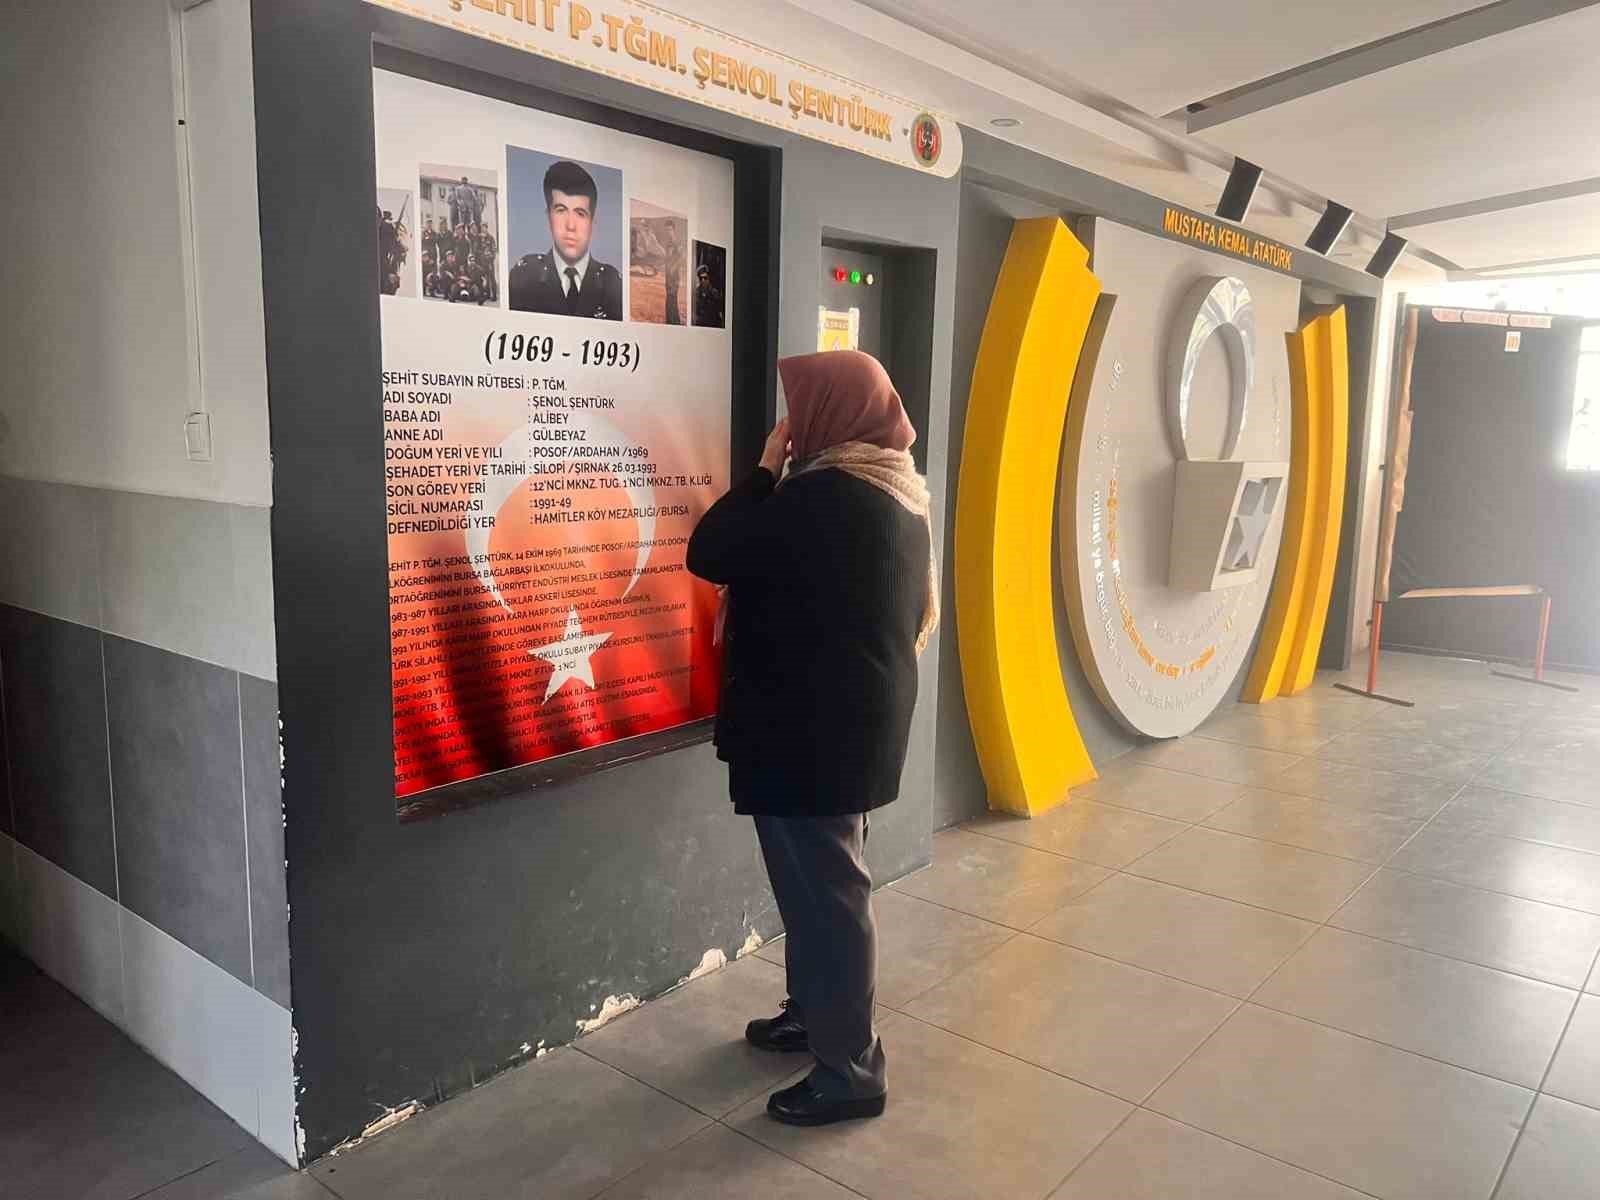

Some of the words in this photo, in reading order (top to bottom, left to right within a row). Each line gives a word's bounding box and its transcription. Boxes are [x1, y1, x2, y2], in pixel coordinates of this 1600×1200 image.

[692, 47, 783, 106] ŞENOL
[788, 79, 894, 142] ŞENTÜRK
[1164, 207, 1216, 247] MUSTAFA
[1217, 226, 1251, 257] KEMAL
[1252, 239, 1292, 270] ATATÜRK
[484, 330, 554, 368] (1969
[581, 338, 640, 373] 1993)
[382, 368, 419, 389] ŞEHİT
[421, 373, 473, 387] SUBAYIN
[477, 373, 524, 389] RÜTBESİ
[544, 376, 567, 390] TĞM.
[383, 390, 404, 403] ADI
[407, 391, 451, 404] SOYADI
[532, 396, 567, 411] ŞENOL
[569, 394, 615, 411] ŞENTÜRK
[384, 409, 418, 422] BABA
[419, 410, 440, 422] ADI
[532, 410, 568, 424] ALİBEY
[384, 428, 420, 440] ANNE
[422, 429, 443, 440] ADI
[532, 427, 586, 440] GÜLBEYAZ
[385, 444, 432, 459] DOĞUM
[435, 444, 462, 459] YERİ
[464, 447, 479, 458] VE
[482, 447, 502, 458] YILI
[533, 446, 619, 457] POSOF/ARDAHAN
[385, 465, 443, 482] ŞEHADET
[445, 462, 471, 476] YERİ
[473, 464, 488, 475] VE
[490, 461, 525, 475] TARİHİ
[533, 460, 565, 474] SİLOPİ
[611, 461, 657, 474] 26.03.1993
[386, 485, 414, 496] SON
[416, 480, 458, 495] GÖREV
[460, 479, 486, 493] YERİ
[387, 500, 418, 515] SİCİL
[420, 500, 483, 513] NUMARASI
[533, 497, 571, 509] 1991-49
[387, 514, 471, 534] DEFNEDİLDİĞİ
[474, 516, 495, 528] YER
[534, 508, 585, 524] HAMİTLER
[587, 506, 606, 520] KÖY
[388, 559, 410, 572] EHİT
